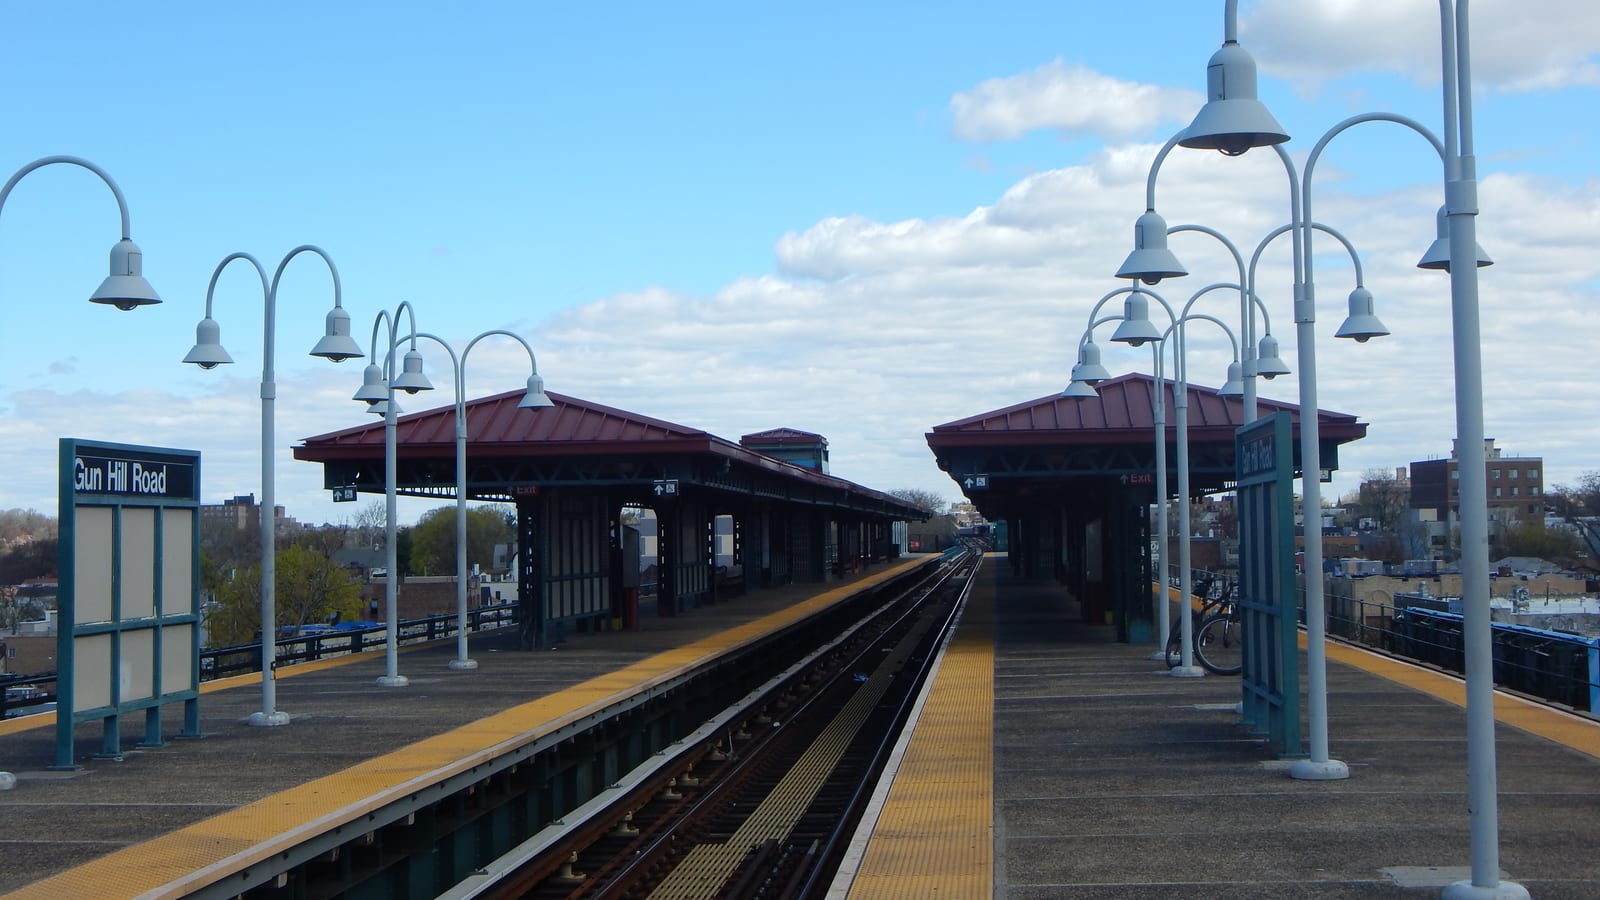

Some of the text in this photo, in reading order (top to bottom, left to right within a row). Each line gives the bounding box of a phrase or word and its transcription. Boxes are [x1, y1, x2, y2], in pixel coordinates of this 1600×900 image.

[74, 458, 166, 493] Gun Hill Road
[1130, 473, 1152, 483] Exit
[516, 486, 538, 495] Exit
